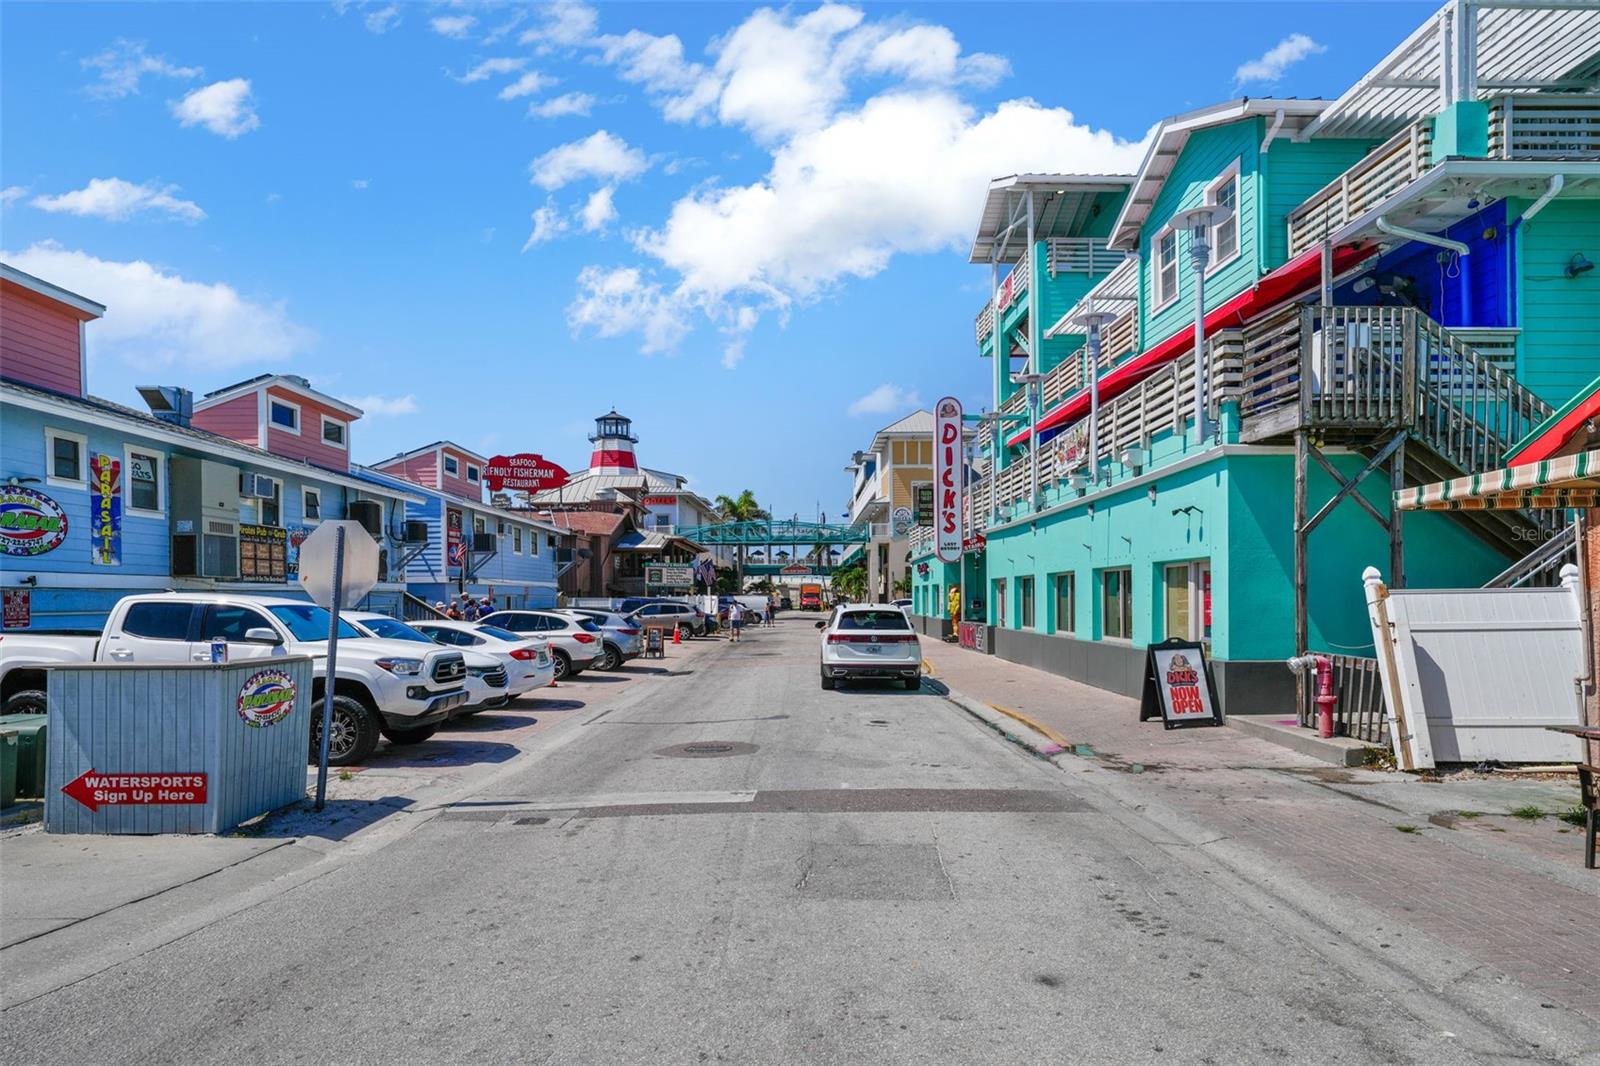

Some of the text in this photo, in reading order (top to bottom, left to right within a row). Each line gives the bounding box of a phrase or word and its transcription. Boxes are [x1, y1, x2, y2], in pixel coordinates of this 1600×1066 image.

[509, 459, 537, 468] SEAFOOD
[481, 466, 554, 478] RIENDLY FISHERMAN
[942, 423, 957, 534] DICK'S
[502, 478, 541, 488] RESTAURANT
[98, 455, 112, 564] PARASAIL
[0, 510, 61, 532] RASAIL
[1167, 670, 1199, 684] DICK'S
[1170, 686, 1200, 700] NOW
[1172, 699, 1204, 714] OPEN
[84, 776, 203, 789] WATERSPORTS
[94, 790, 195, 804] Sign Up Here
